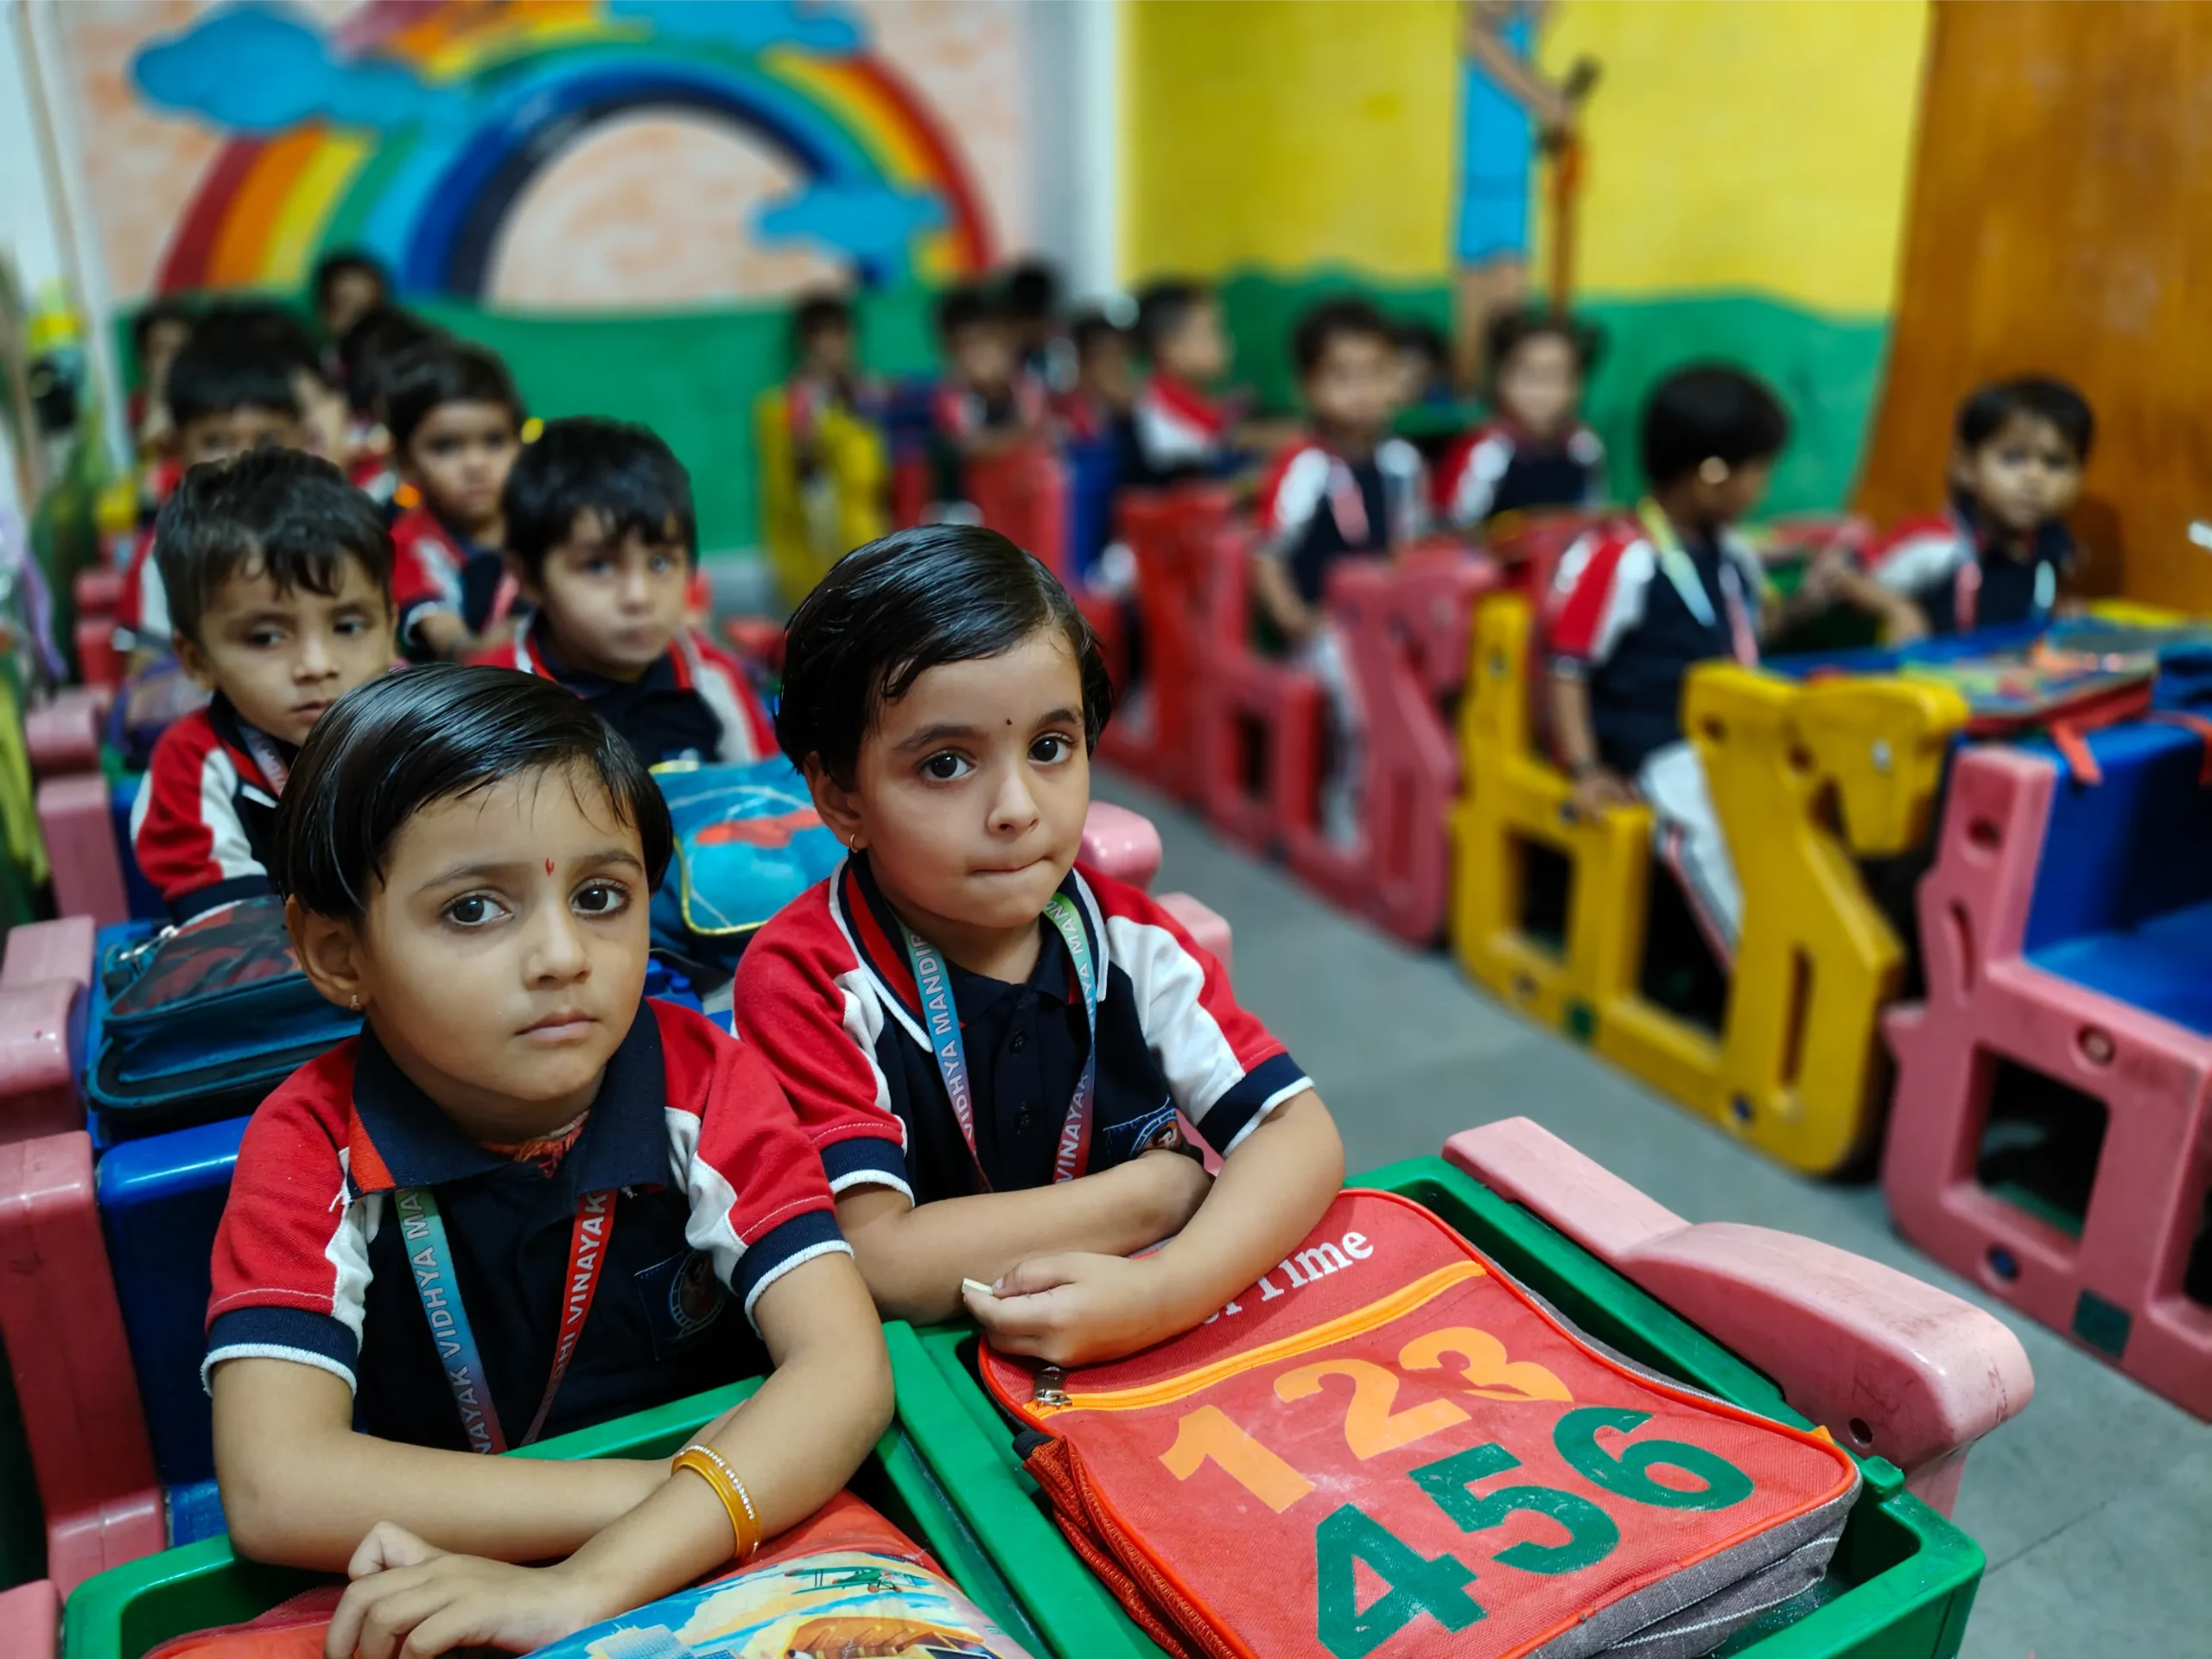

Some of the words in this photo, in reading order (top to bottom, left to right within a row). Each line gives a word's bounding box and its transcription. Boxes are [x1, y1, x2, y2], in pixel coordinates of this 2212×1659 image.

[941, 1039, 973, 1140] VIDHYA
[412, 1246, 461, 1359] VIDHYA
[567, 1192, 607, 1325] VINAYAK
